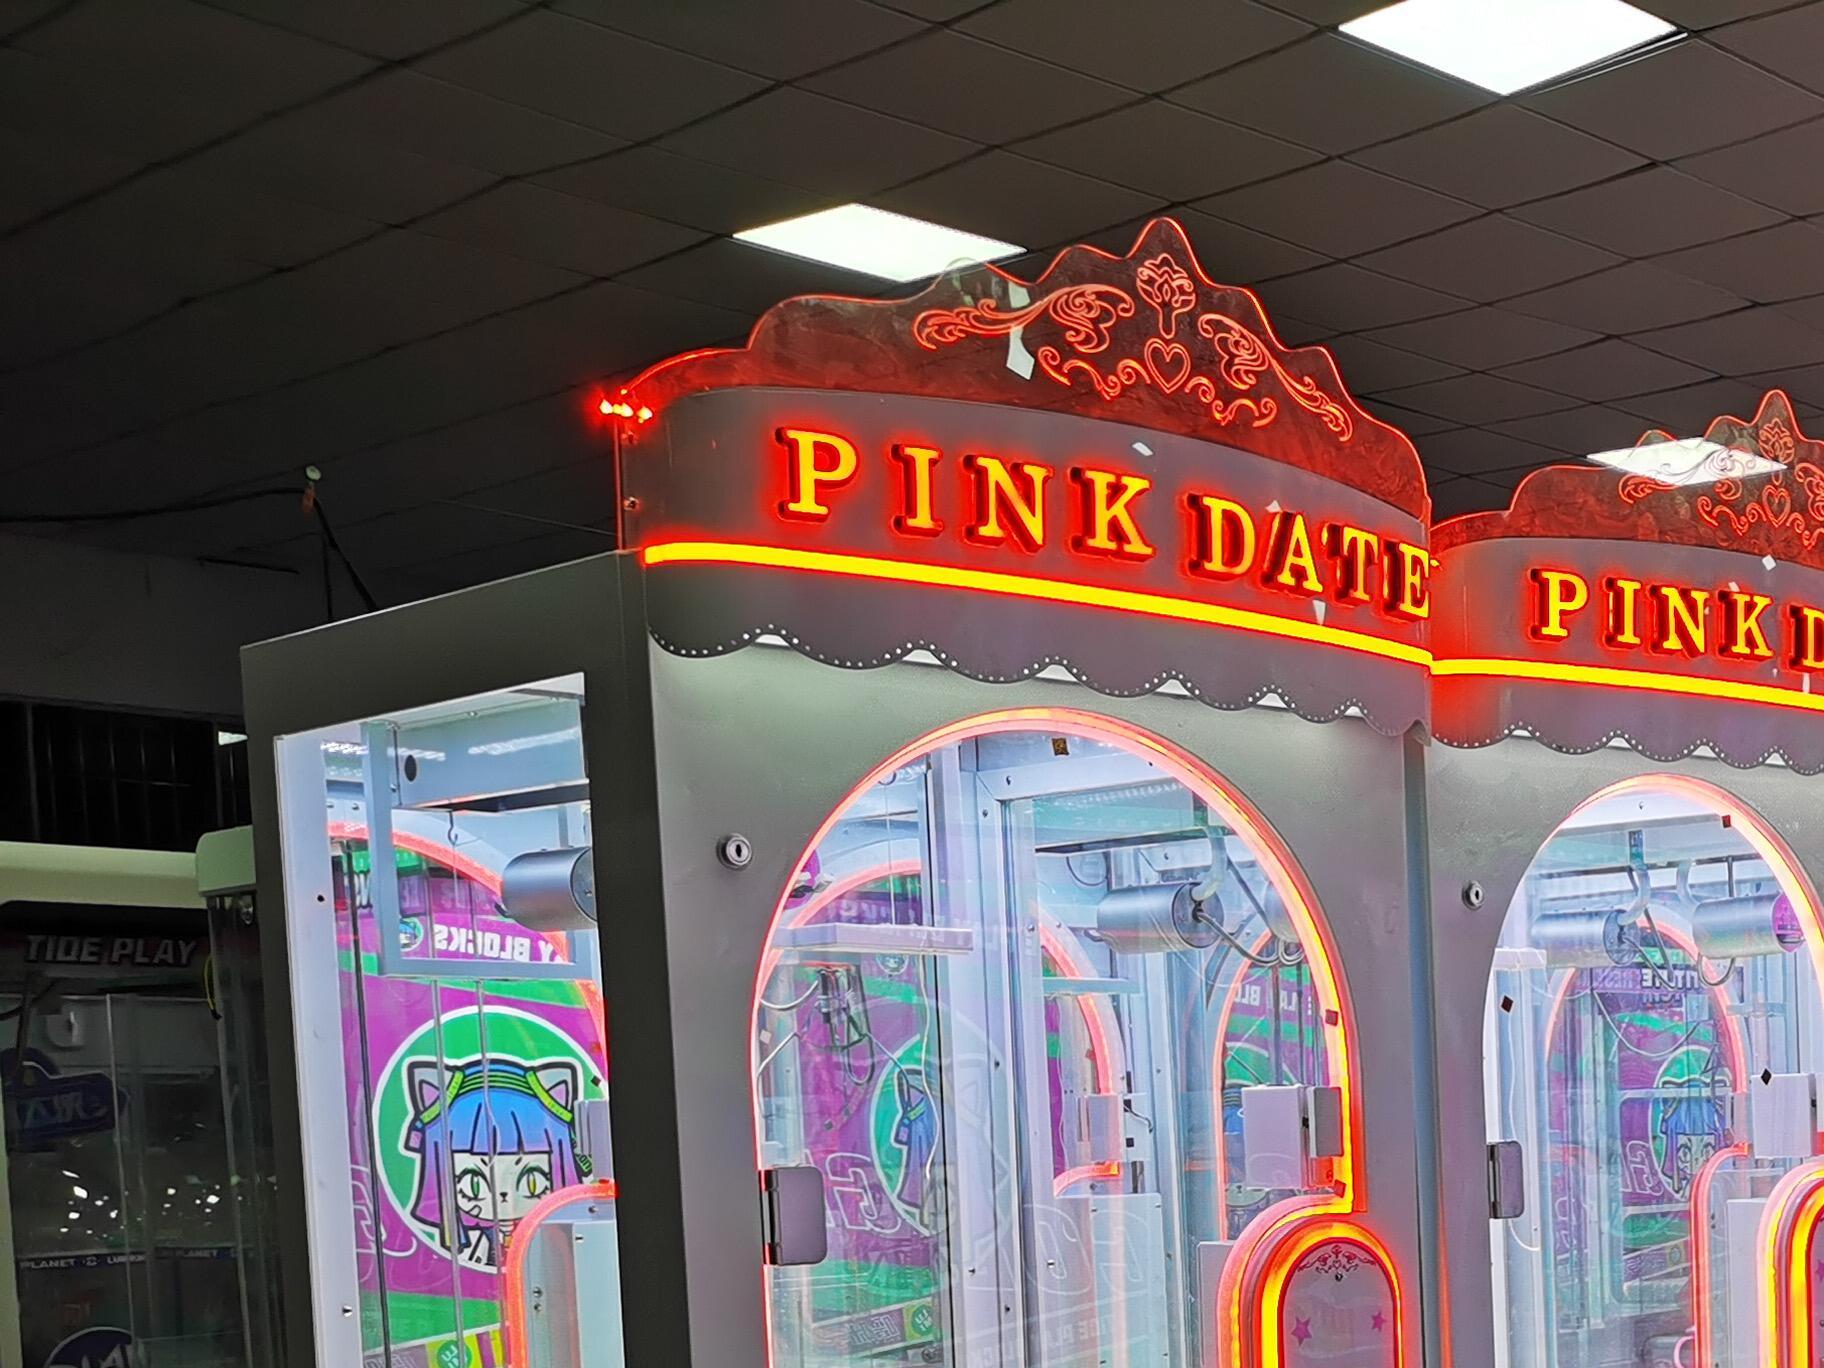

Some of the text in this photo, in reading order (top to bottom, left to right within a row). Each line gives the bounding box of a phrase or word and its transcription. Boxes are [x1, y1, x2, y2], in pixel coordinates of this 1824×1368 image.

[777, 428, 1432, 621] PINK DATE
[1531, 568, 1774, 661] PINK
[25, 935, 198, 966] TIDE PLAY
